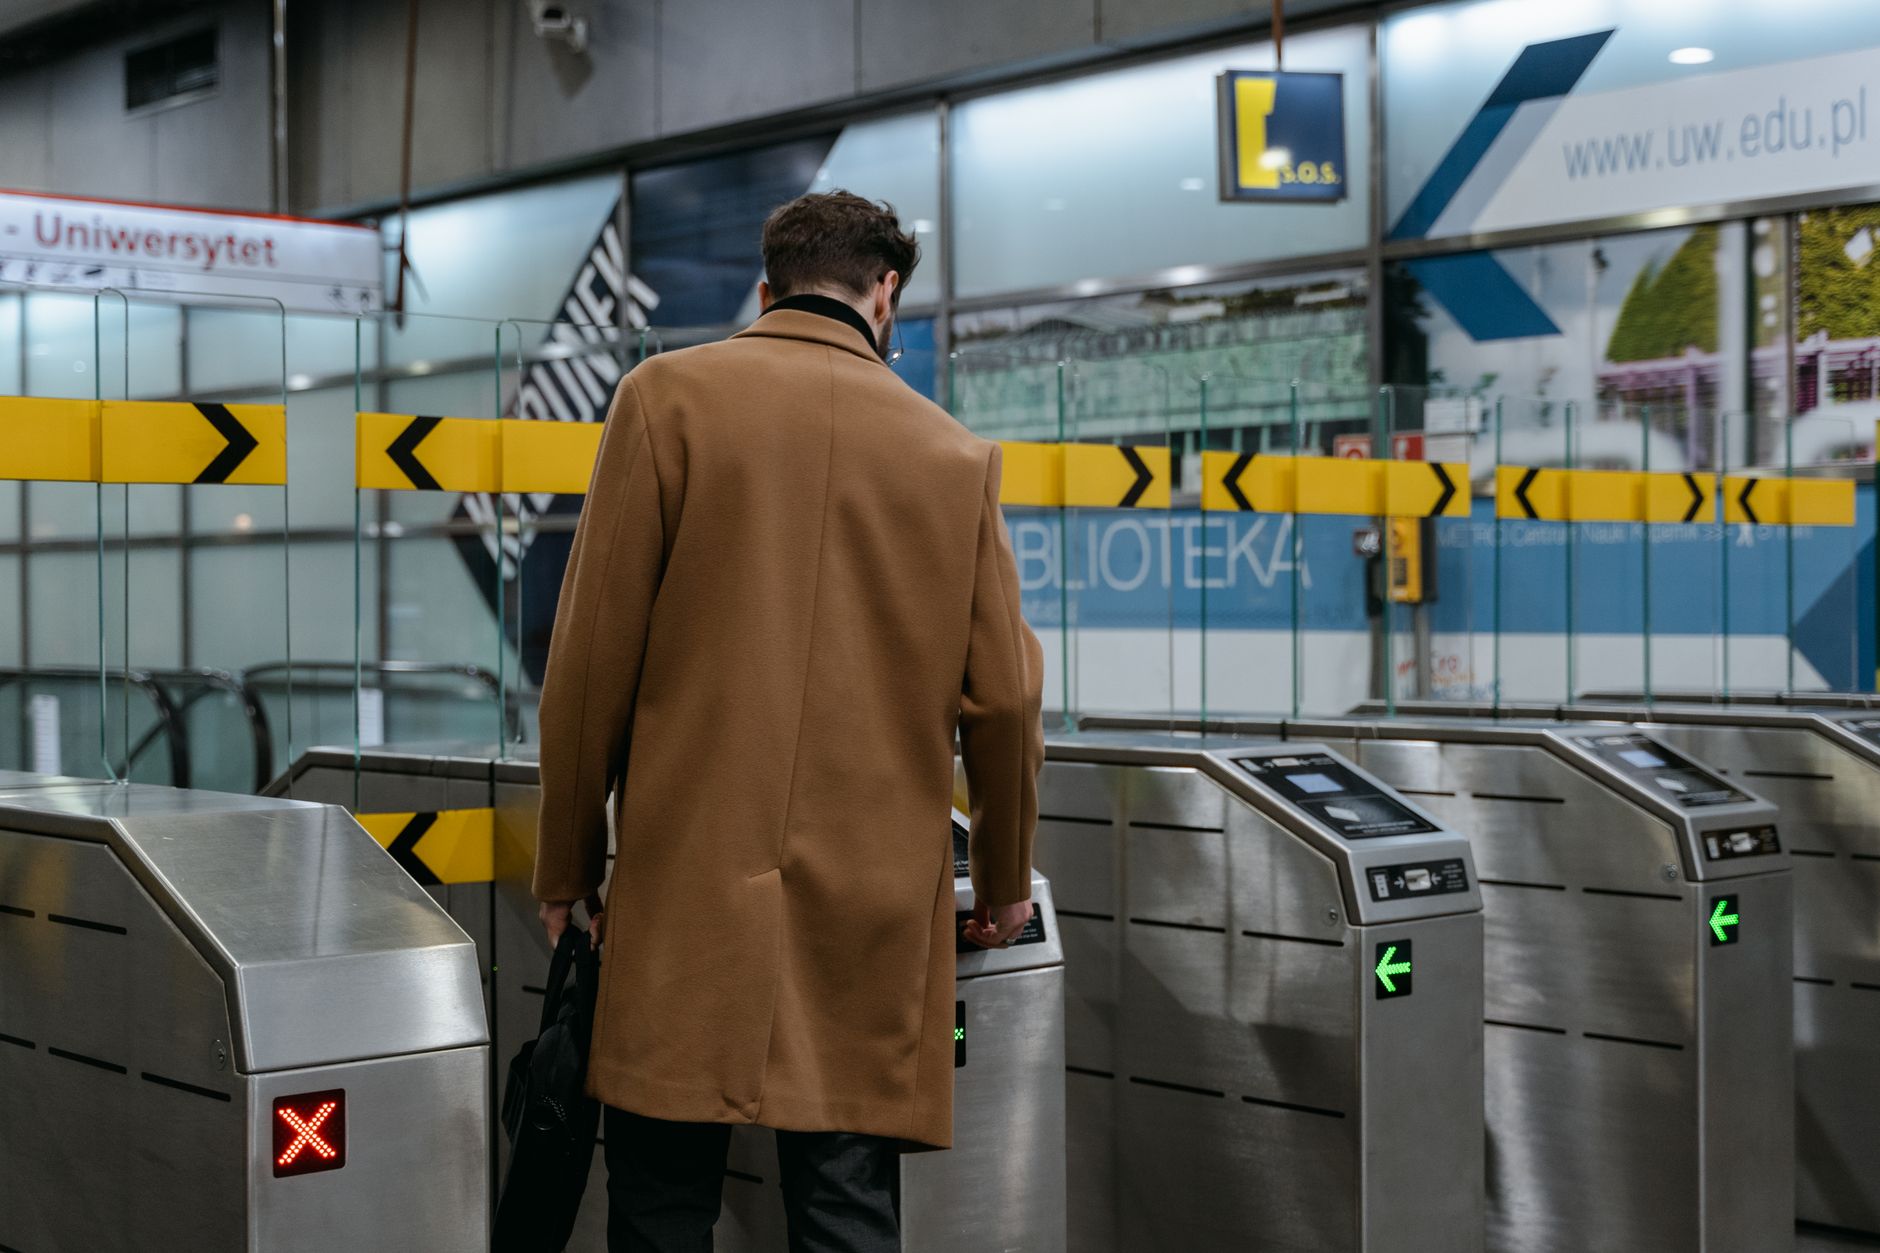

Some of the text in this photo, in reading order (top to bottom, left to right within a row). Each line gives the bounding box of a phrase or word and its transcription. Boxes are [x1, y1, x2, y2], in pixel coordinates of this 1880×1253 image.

[1562, 84, 1867, 181] www.uw.edu.pl
[34, 209, 278, 271] Uniwersytet
[1003, 514, 1313, 592] BLIOTEKA
